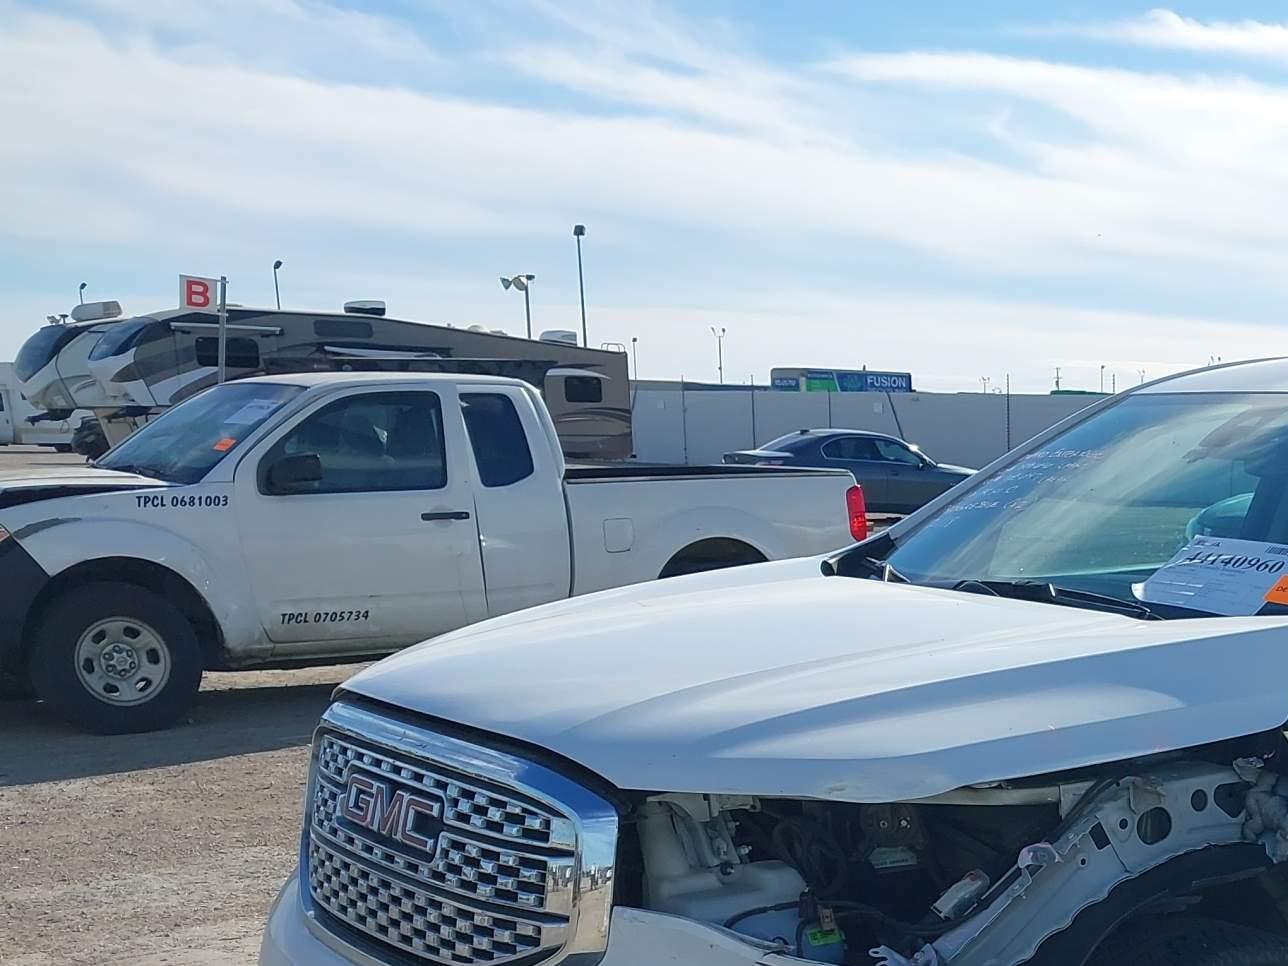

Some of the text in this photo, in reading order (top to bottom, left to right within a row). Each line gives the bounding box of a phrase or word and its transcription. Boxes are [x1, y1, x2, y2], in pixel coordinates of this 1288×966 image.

[187, 280, 209, 307] B
[866, 375, 907, 388] FUSION
[136, 495, 229, 508] TPCL 0681003
[280, 610, 369, 624] TPCL 0705734
[344, 774, 440, 854] GMC
